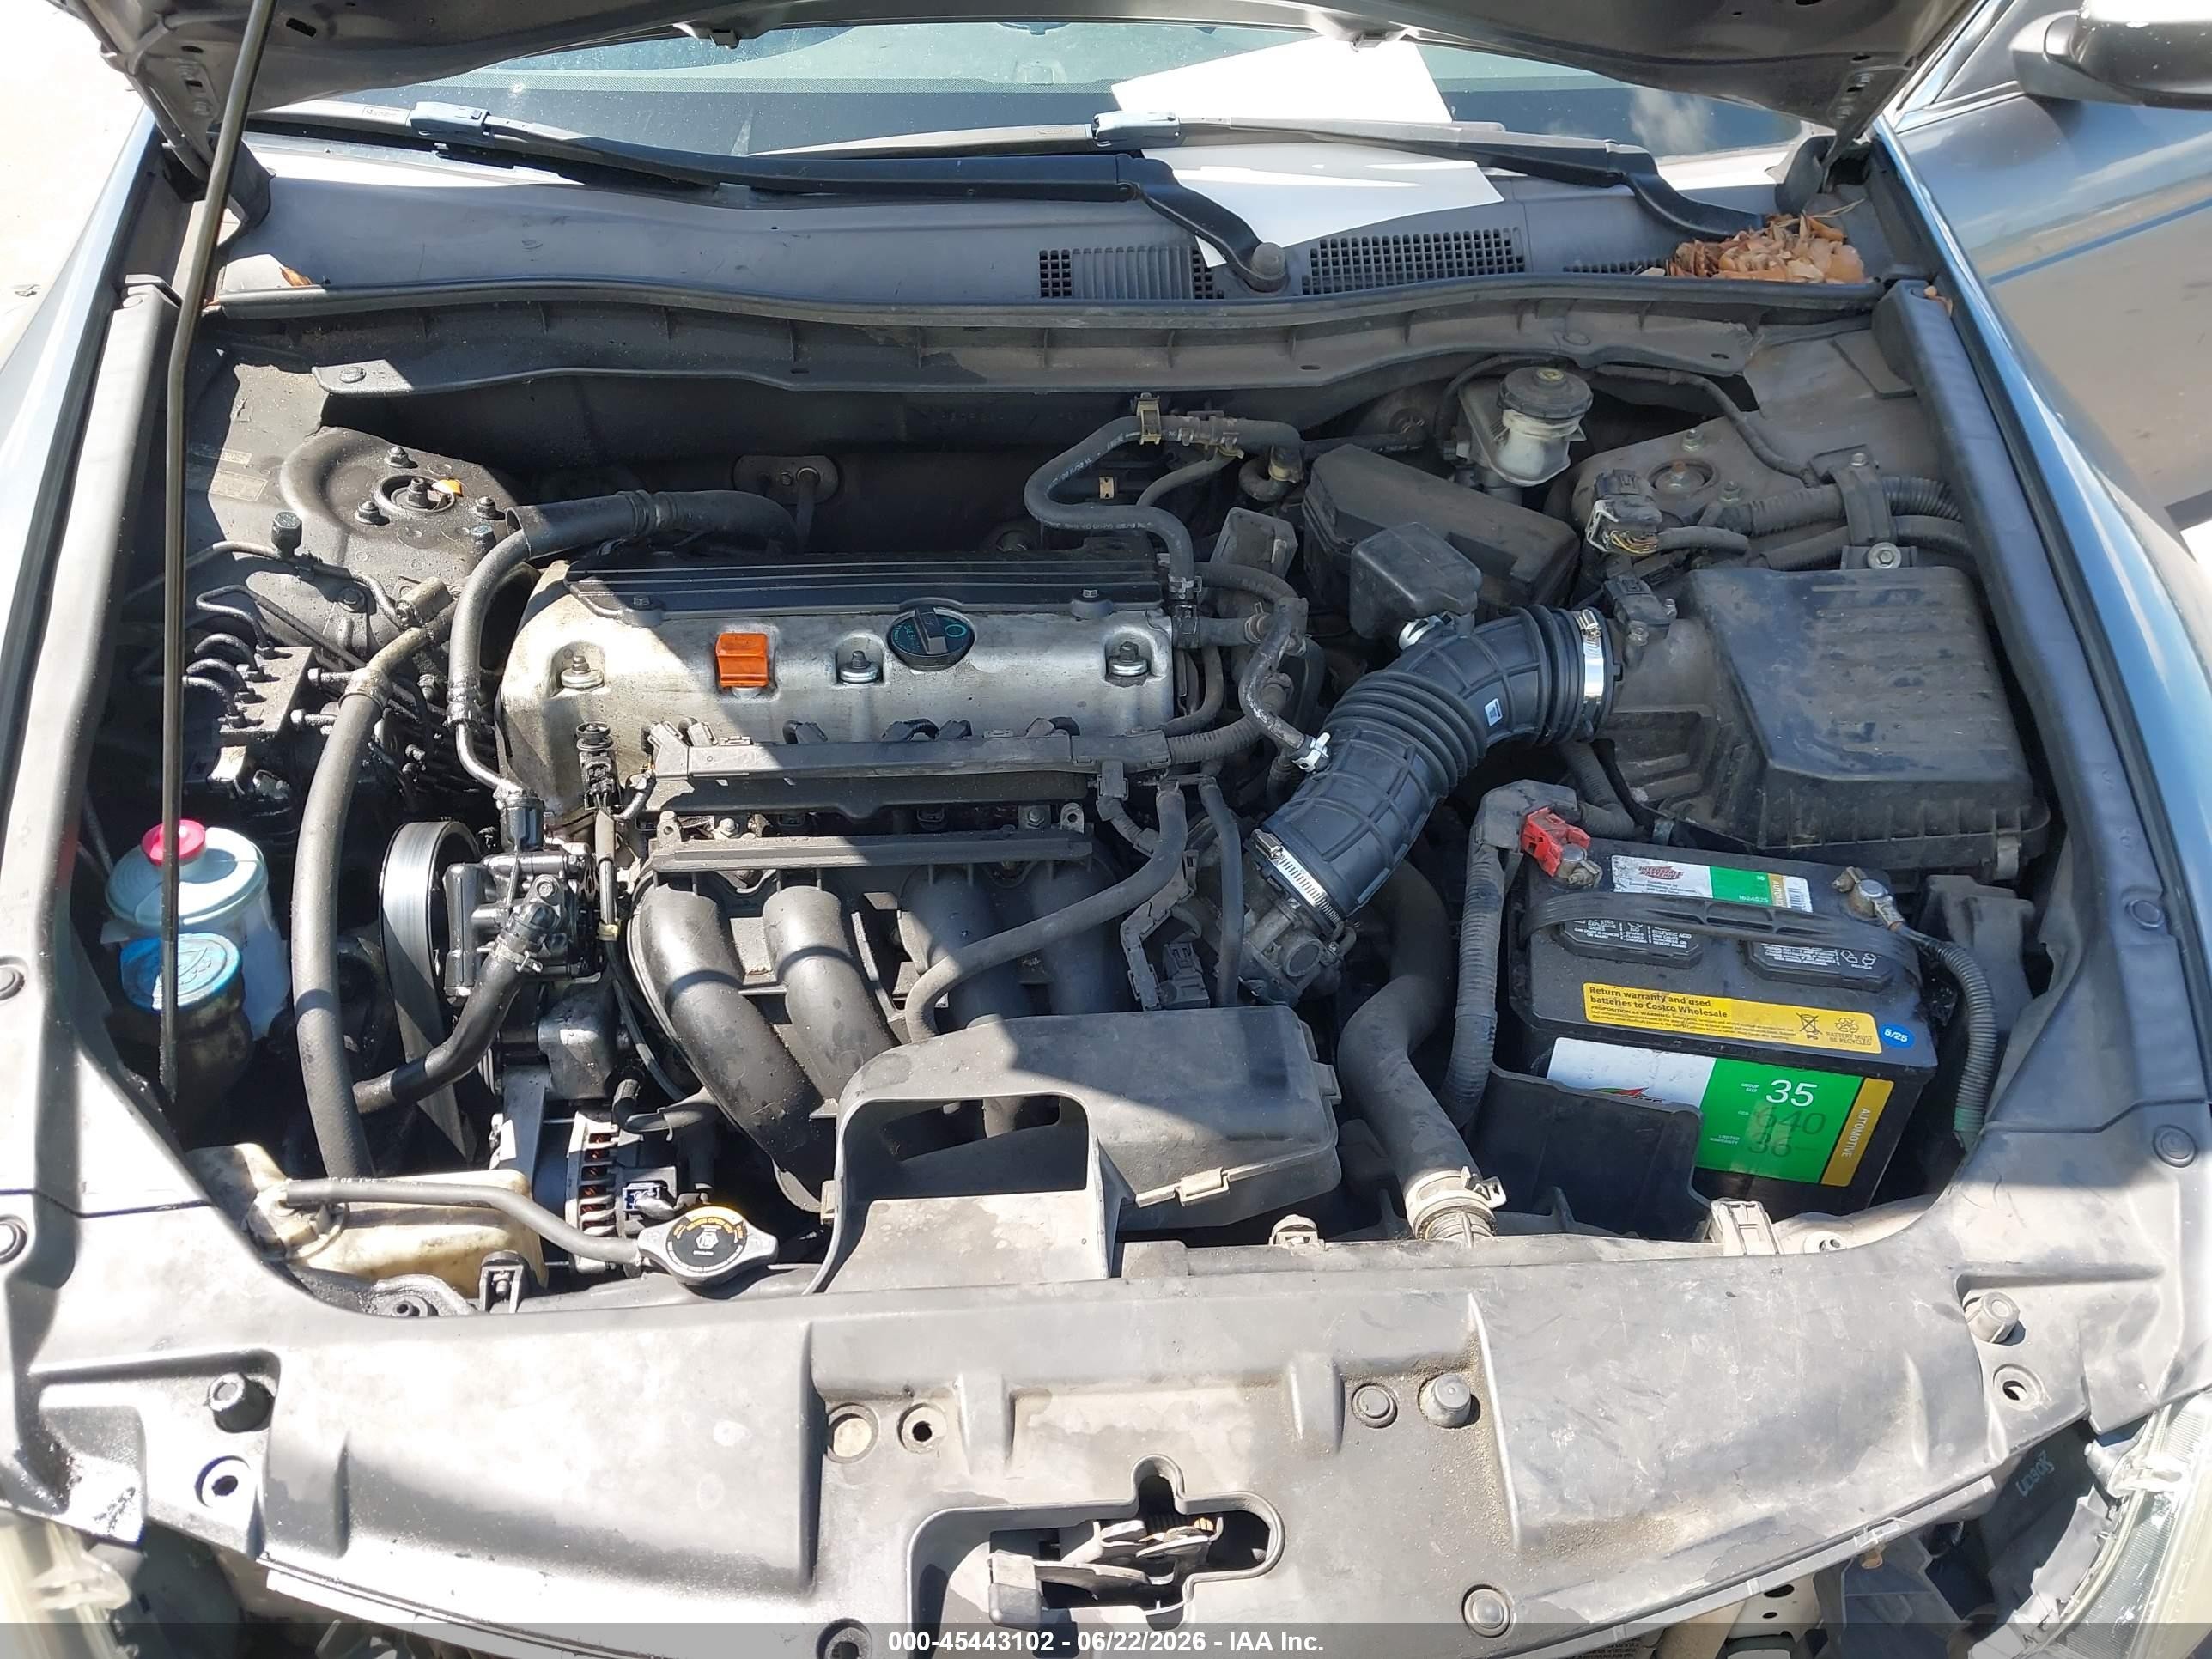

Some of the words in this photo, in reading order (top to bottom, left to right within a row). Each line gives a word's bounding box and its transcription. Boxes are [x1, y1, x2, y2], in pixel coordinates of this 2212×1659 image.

[1589, 987, 1621, 997] Return
[1624, 990, 1666, 1003] warranty
[1688, 999, 1711, 1007] used
[1590, 996, 1632, 1007] batteries
[1634, 1000, 1644, 1009] to
[1646, 1001, 1675, 1012] Costco
[1678, 1006, 1728, 1018] Wholesale
[1765, 1079, 1818, 1107] 35
[1841, 1108, 1872, 1158] AUTOMOTIVE
